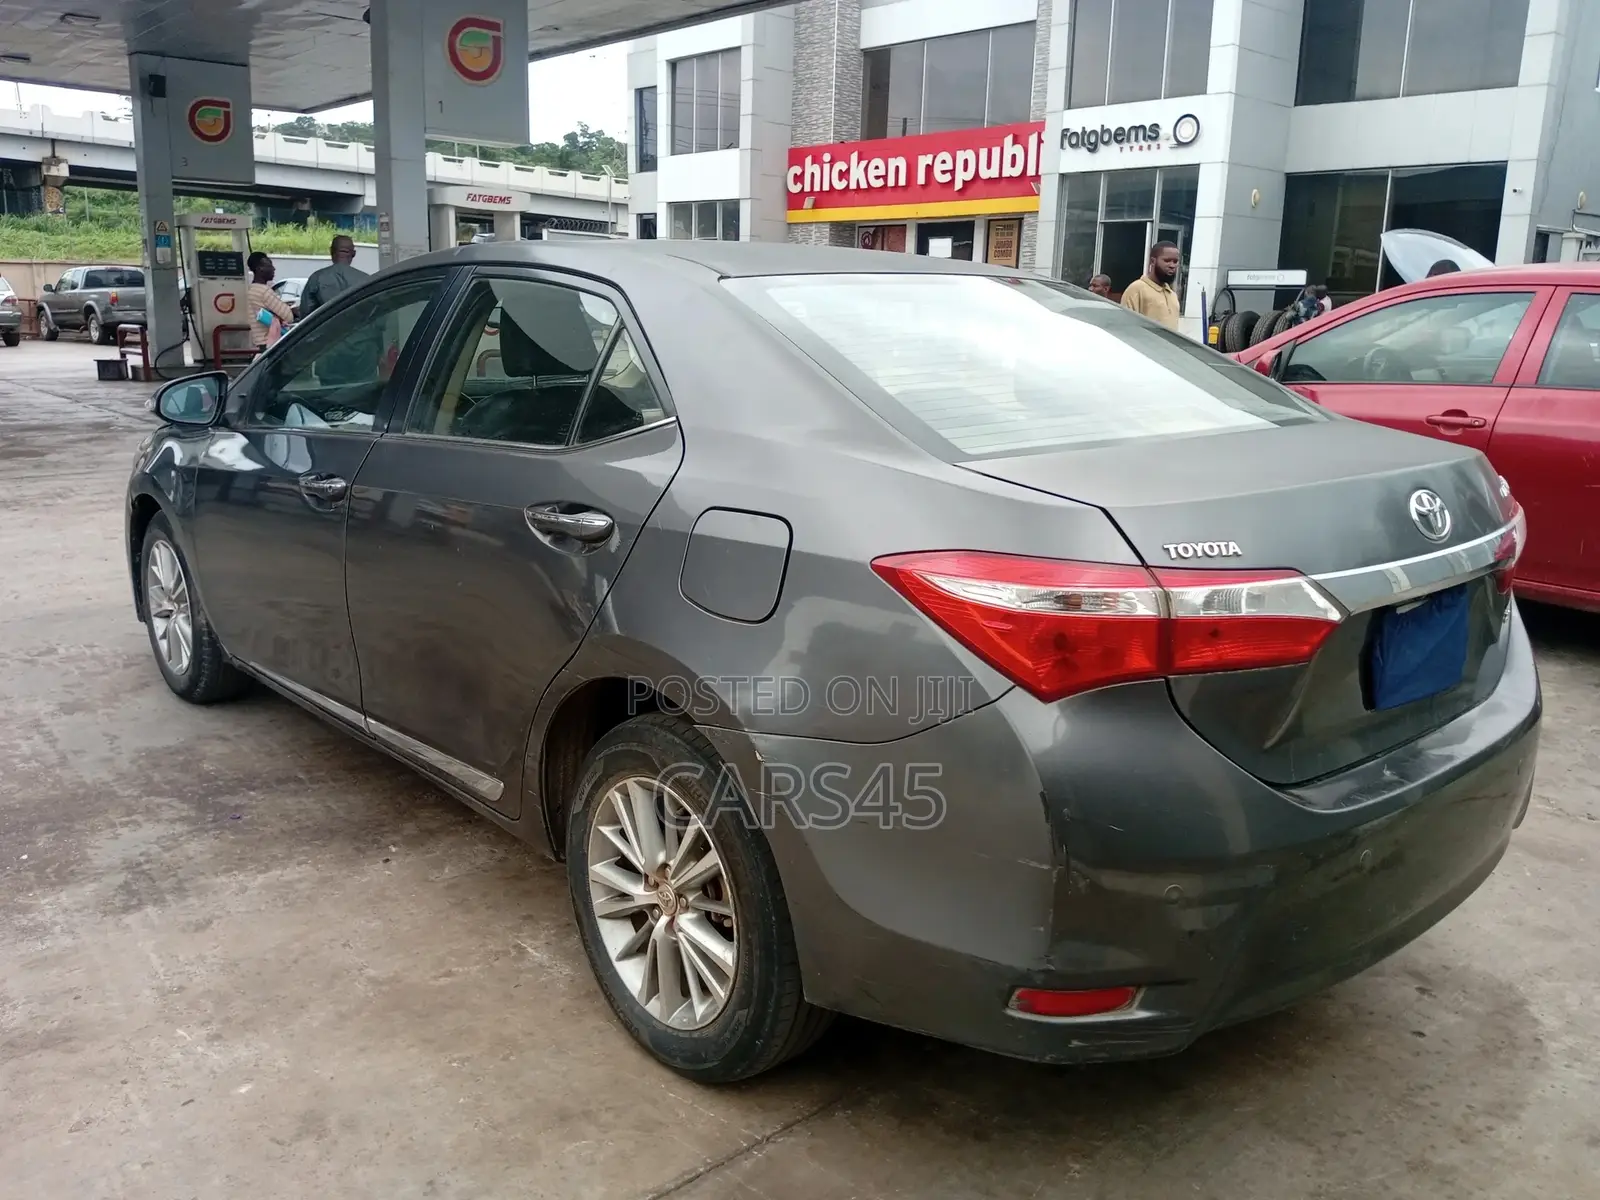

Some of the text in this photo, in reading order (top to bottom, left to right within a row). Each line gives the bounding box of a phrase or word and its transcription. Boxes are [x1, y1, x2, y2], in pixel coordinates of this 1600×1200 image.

[786, 151, 907, 194] chicken
[466, 192, 513, 205] FATGBEMS
[200, 216, 237, 225] FATGBEMS
[1163, 540, 1242, 559] TOYOTA
